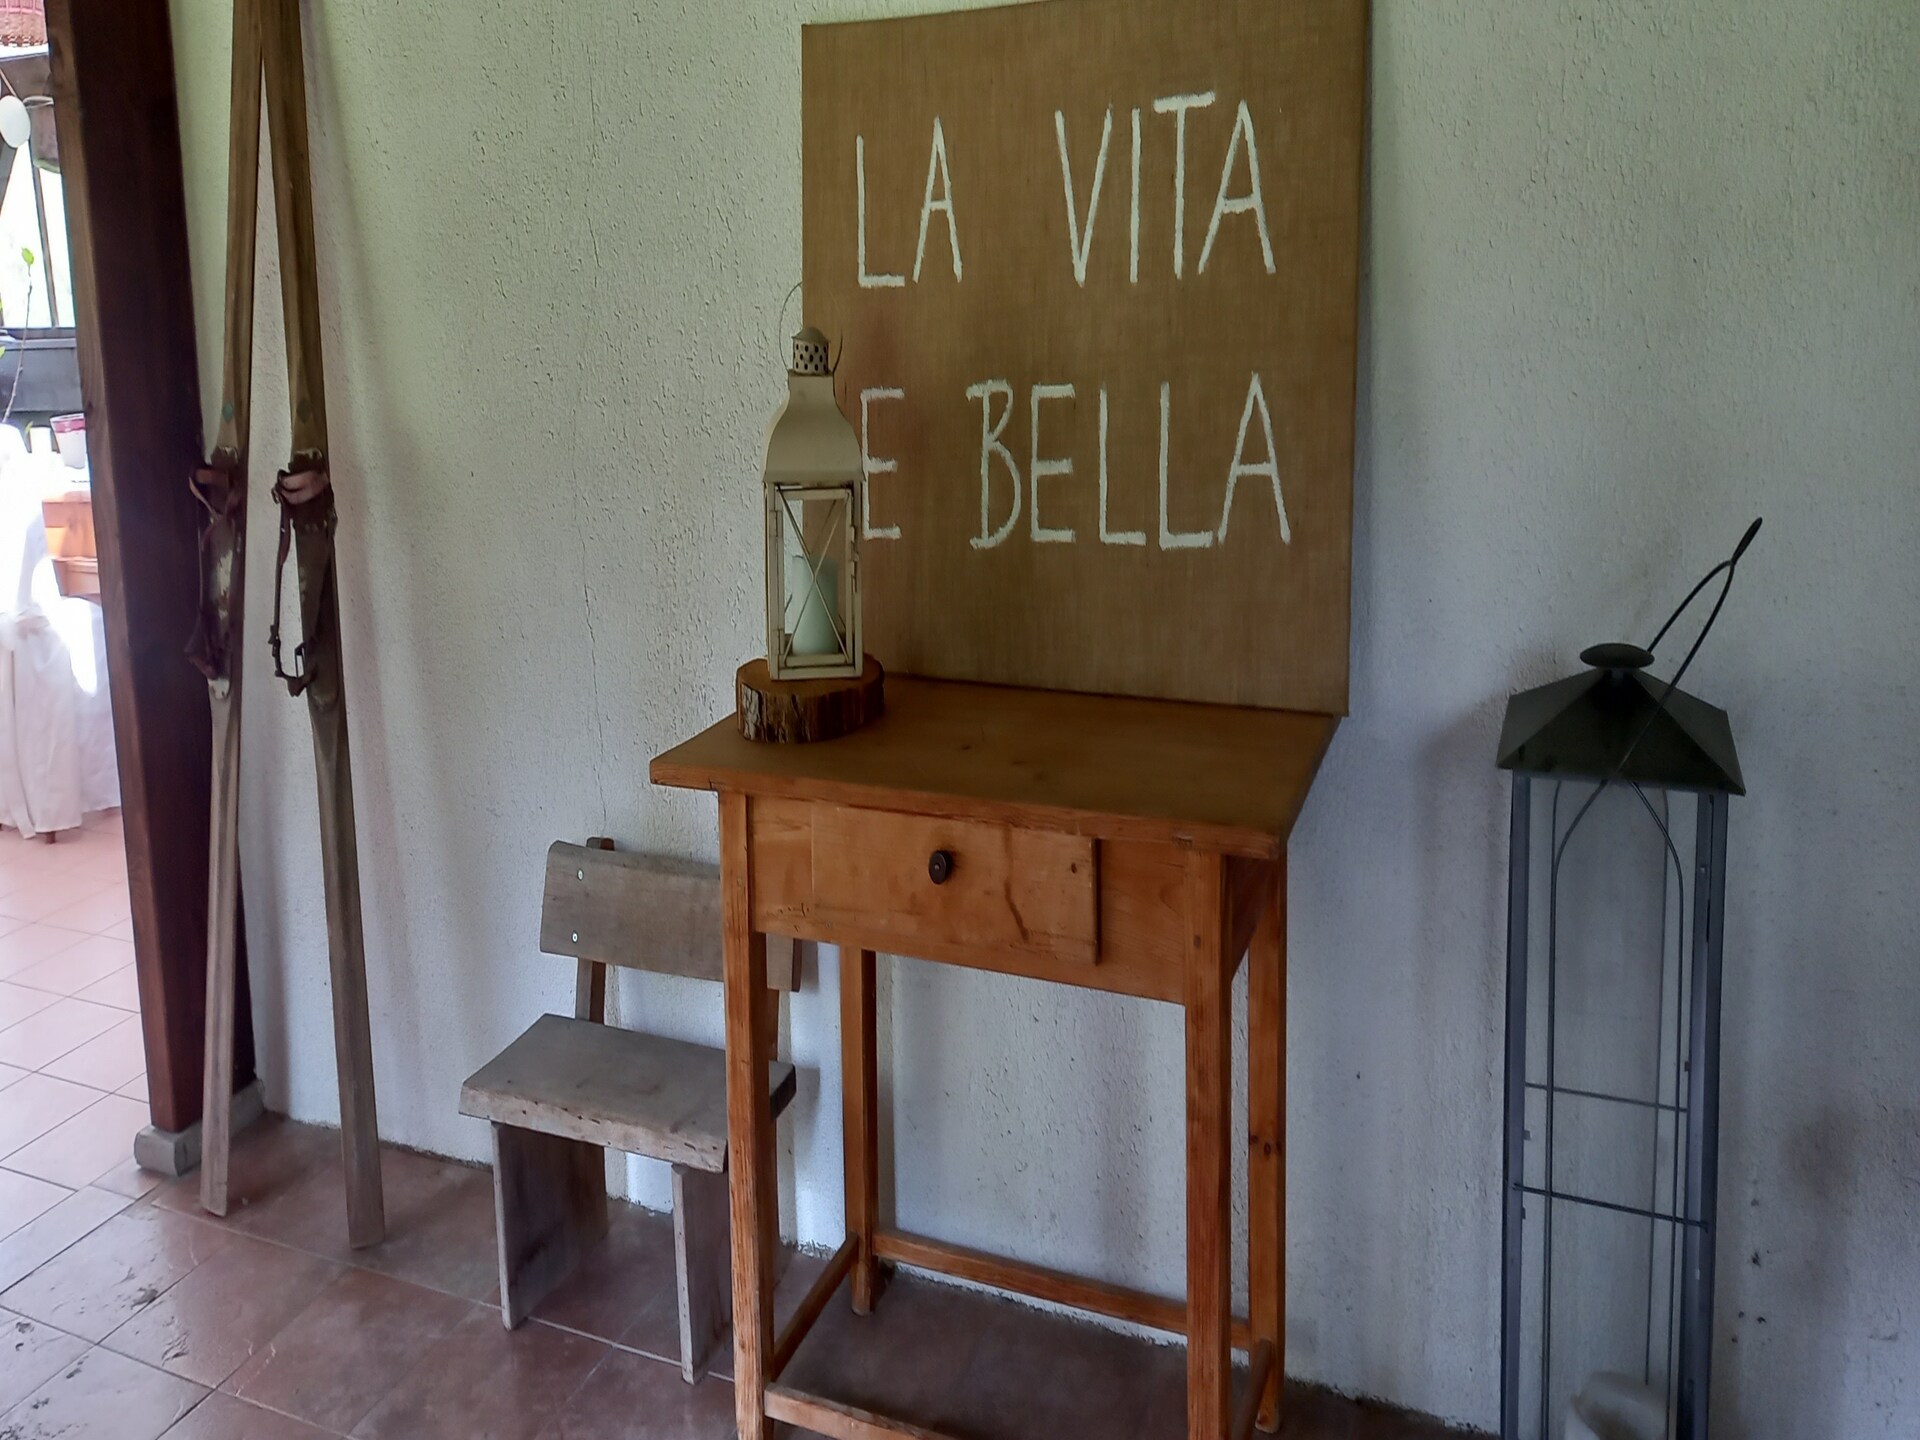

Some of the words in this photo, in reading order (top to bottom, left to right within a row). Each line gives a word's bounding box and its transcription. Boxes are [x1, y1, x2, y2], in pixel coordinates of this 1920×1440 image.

[856, 116, 963, 288] LA
[1054, 91, 1276, 288] VITA
[860, 387, 905, 541] E
[966, 371, 1291, 550] BELLA
